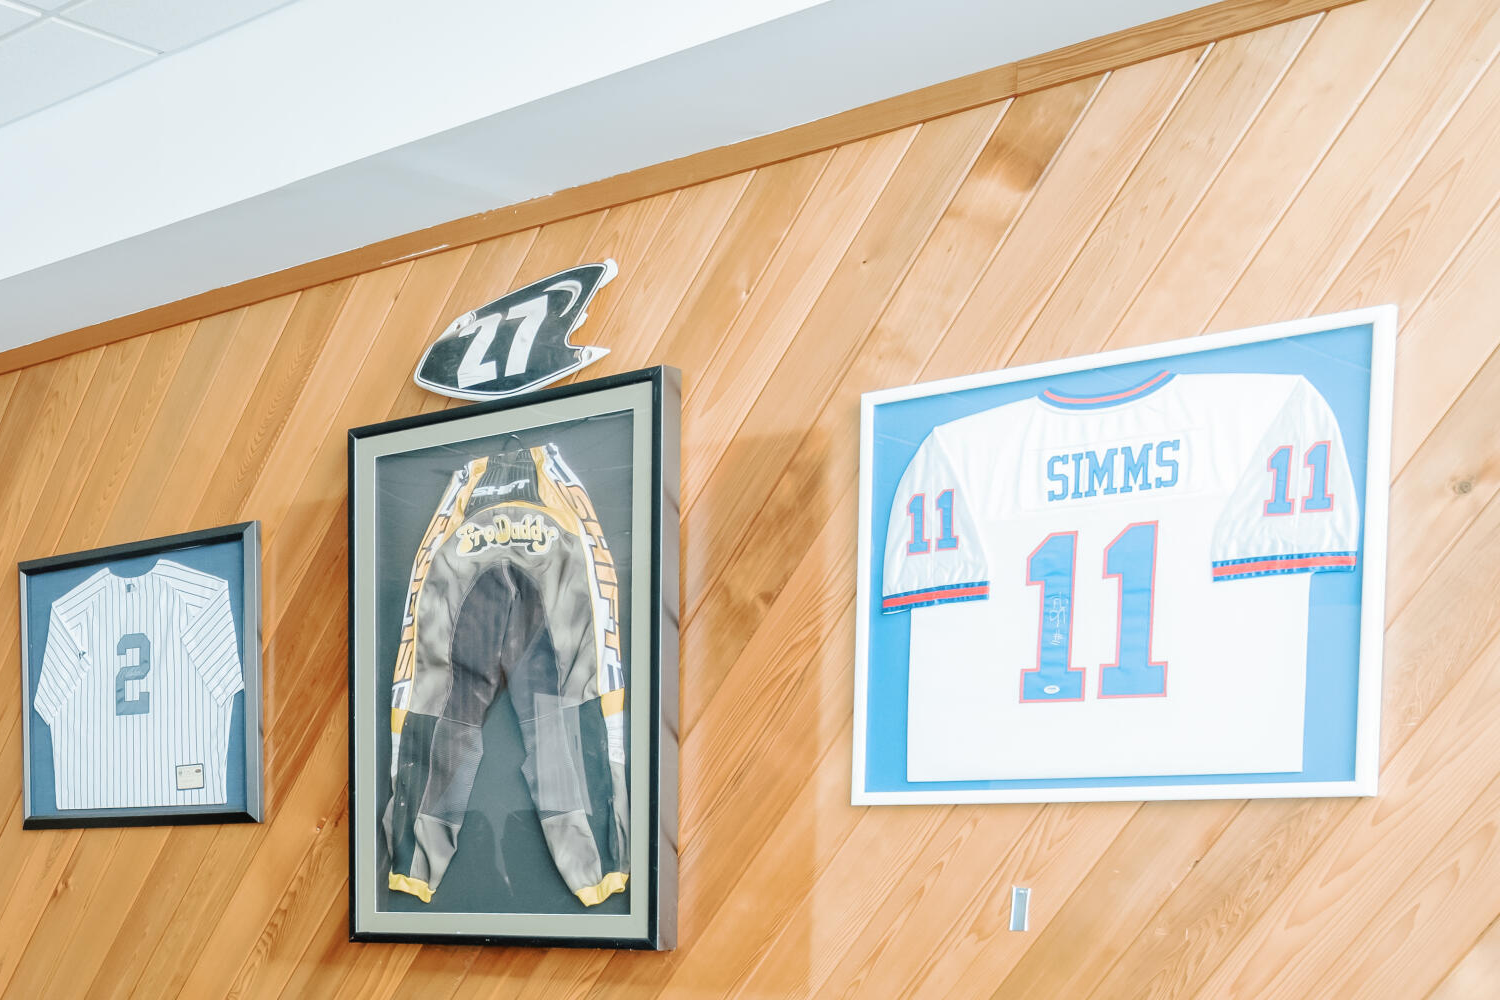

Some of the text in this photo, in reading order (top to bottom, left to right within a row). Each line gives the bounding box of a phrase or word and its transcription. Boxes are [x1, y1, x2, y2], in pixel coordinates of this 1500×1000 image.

[457, 294, 548, 389] 27
[1047, 439, 1181, 502] SIMMS
[1263, 440, 1334, 517] 11
[906, 488, 959, 556] 11
[1019, 520, 1168, 704] 11
[116, 633, 150, 716] 2
